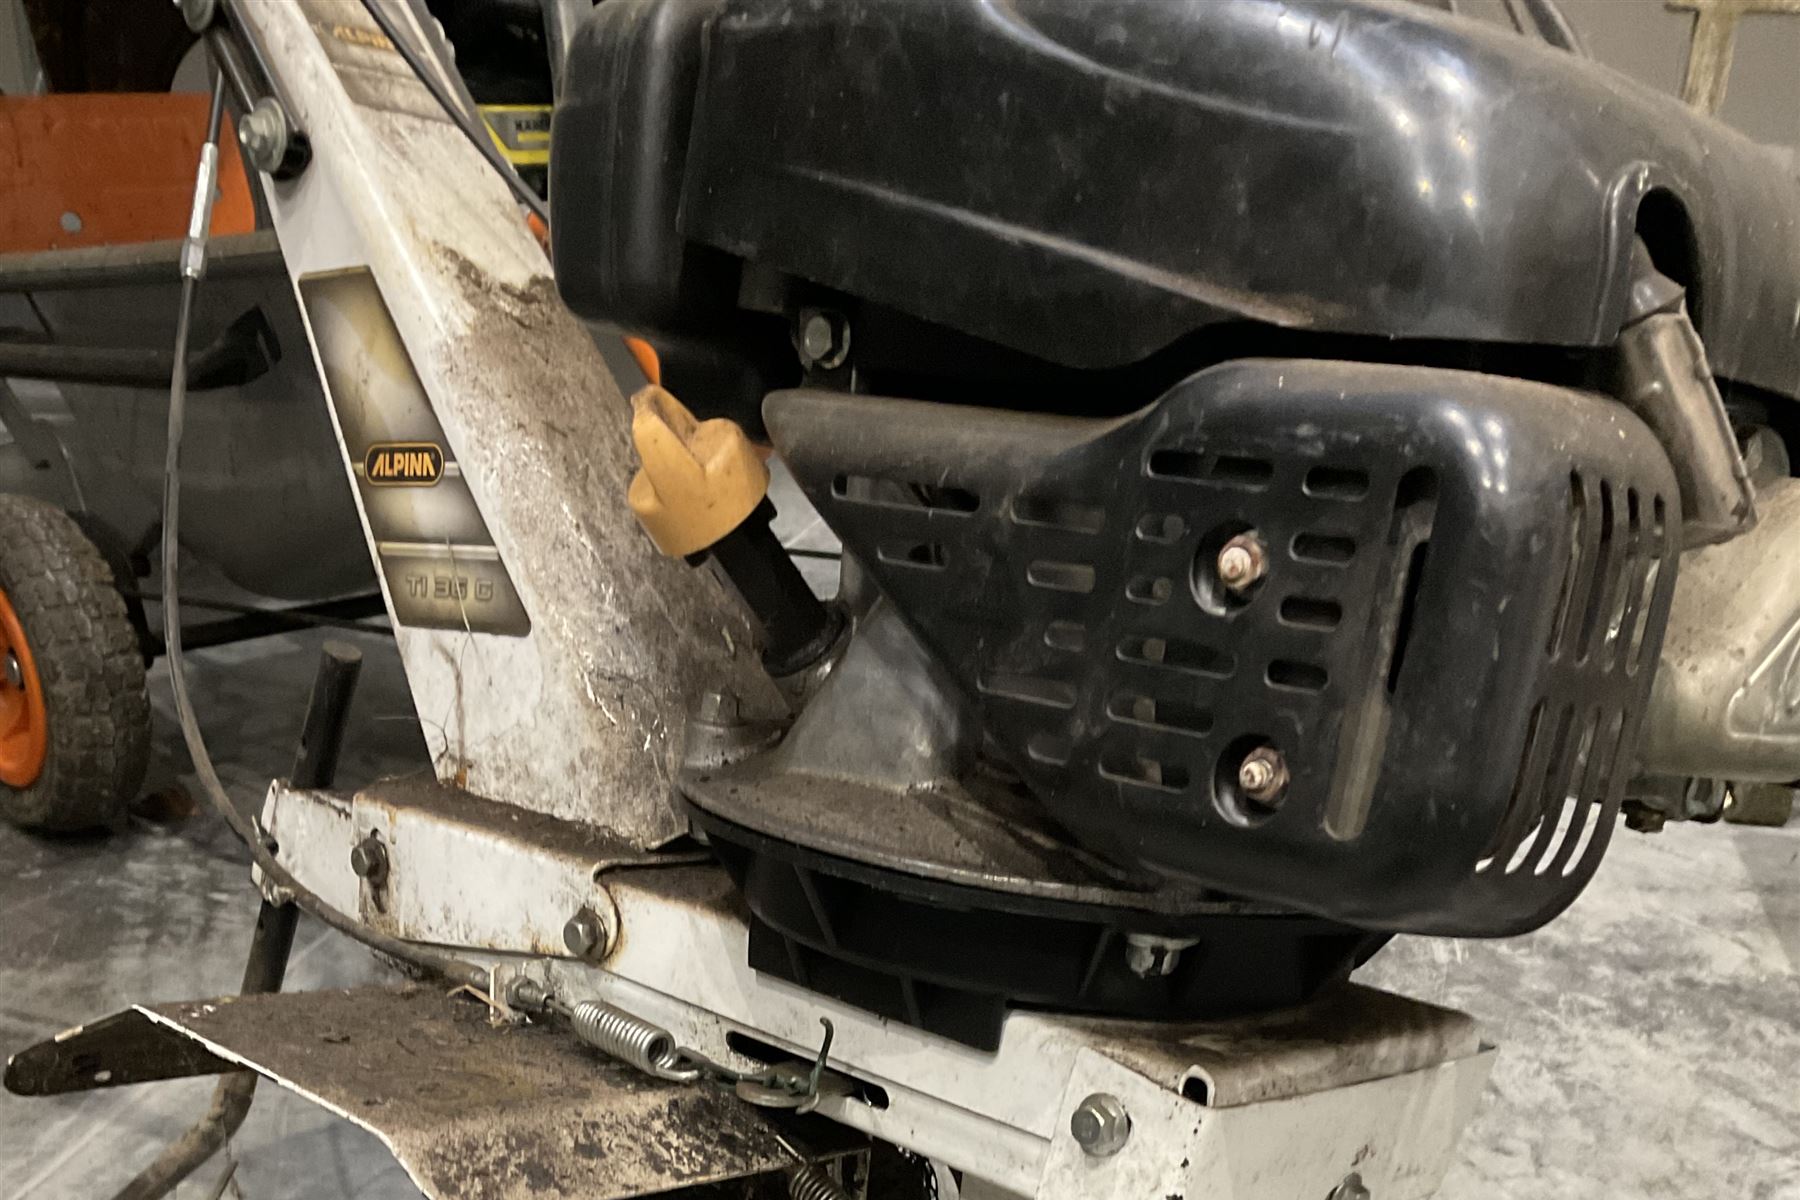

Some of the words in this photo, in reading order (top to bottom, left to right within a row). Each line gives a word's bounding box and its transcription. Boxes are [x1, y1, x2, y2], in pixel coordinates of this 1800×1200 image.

[372, 452, 435, 477] ALPINA
[406, 575, 428, 598] TI
[475, 577, 494, 601] G
